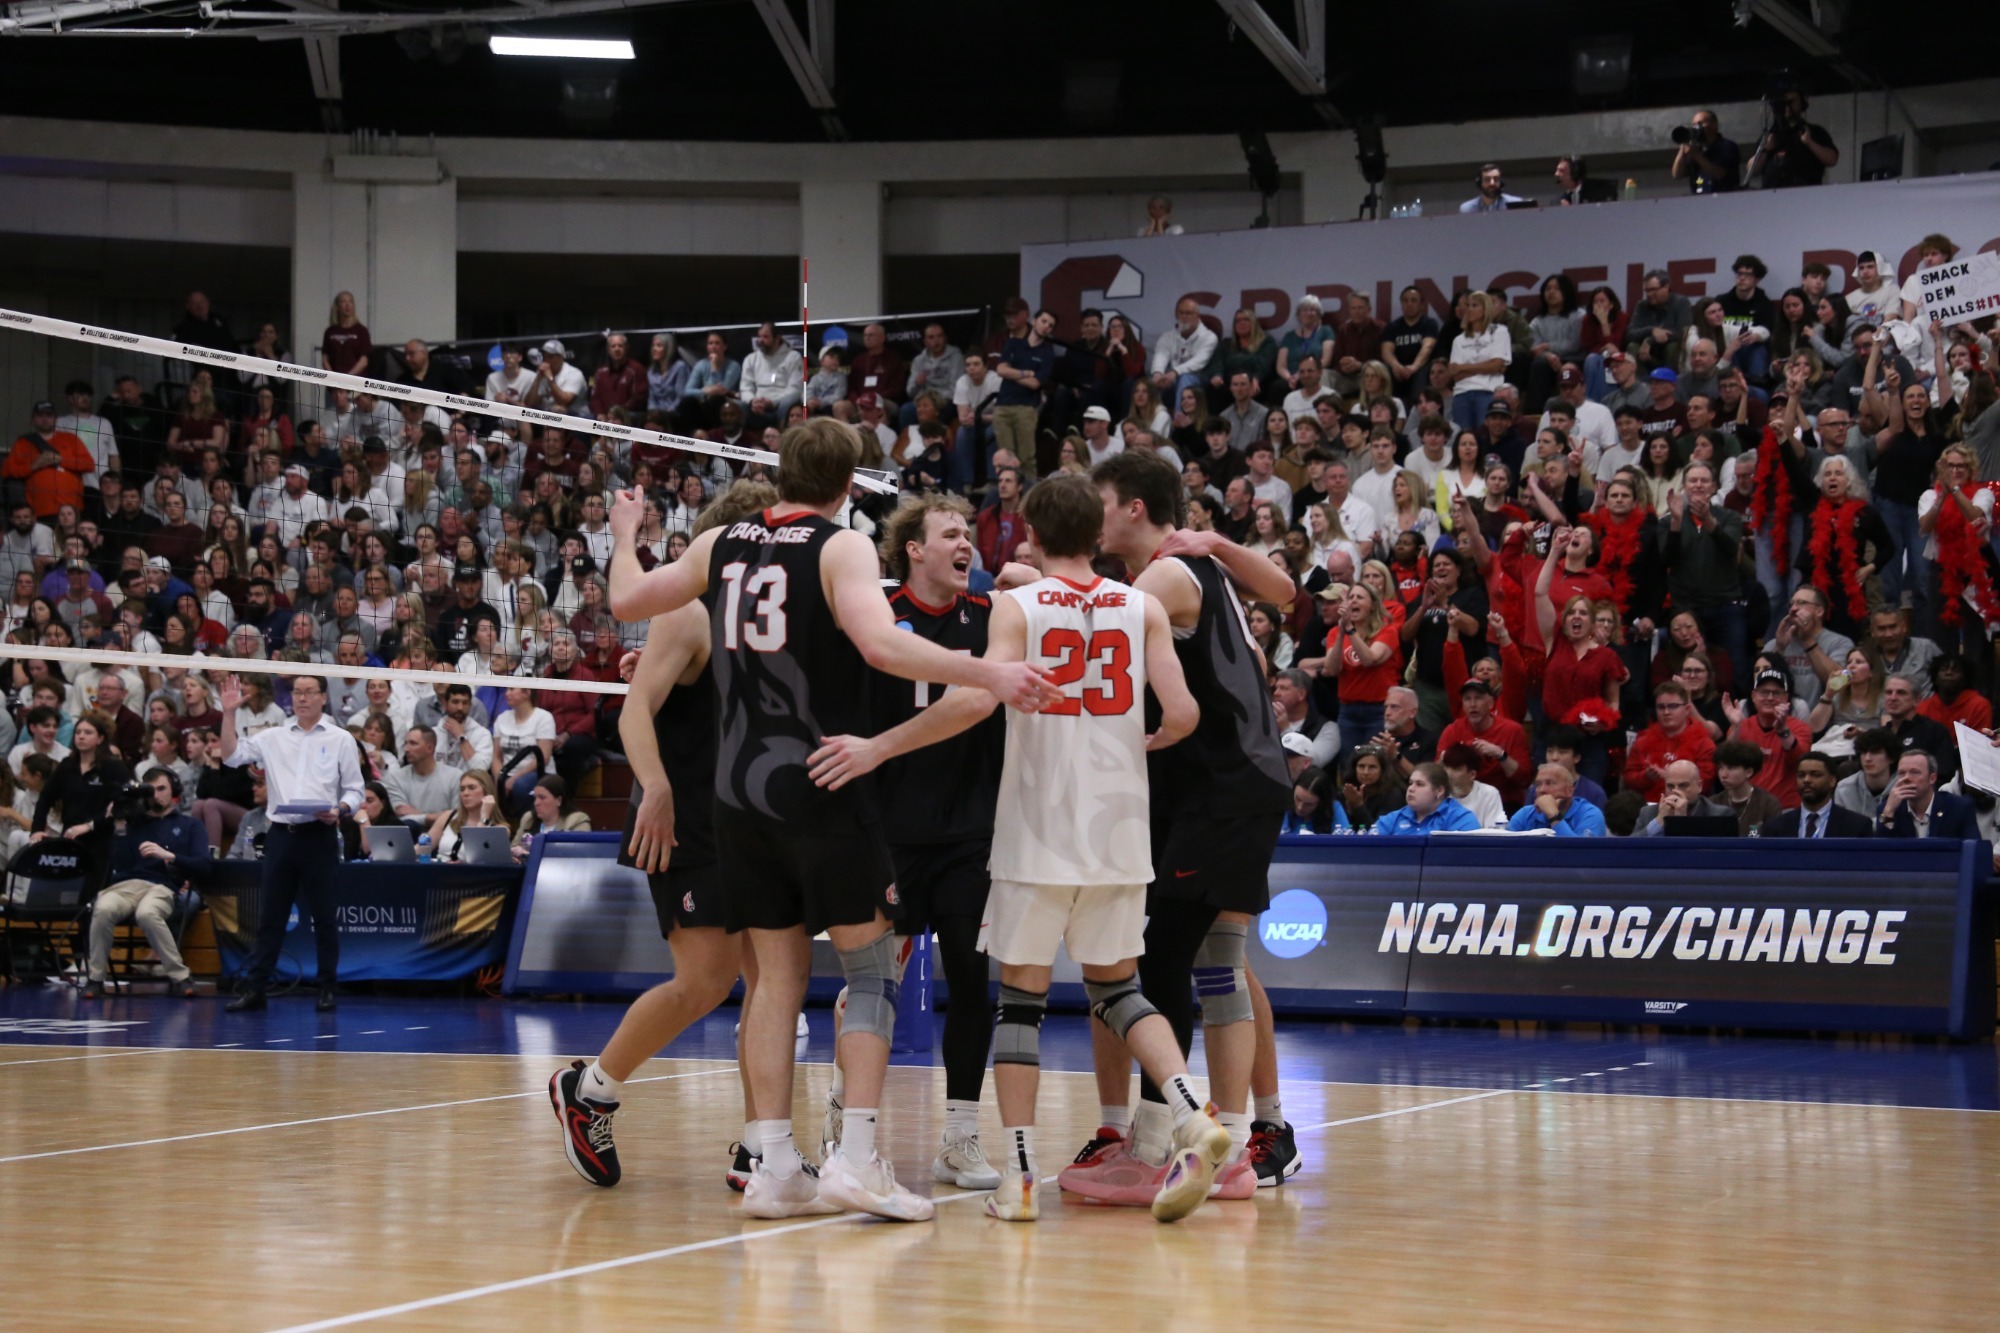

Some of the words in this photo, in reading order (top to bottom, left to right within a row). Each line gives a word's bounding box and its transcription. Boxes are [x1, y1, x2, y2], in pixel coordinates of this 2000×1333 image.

[1921, 263, 1969, 285] SMACK
[1925, 285, 1955, 304] DEM
[0, 313, 33, 324] CHAMPIONSHIP
[1929, 301, 1974, 322] BALLS
[86, 329, 109, 339] VOLLEYBALL
[109, 333, 139, 344] CHAMPIONSHIP
[188, 348, 209, 358] VOLLEYBALL
[210, 352, 237, 362] CHAMPIONSHIP
[282, 365, 301, 375] VOLLEYBALL
[302, 369, 328, 379] CHAMPIONSHIP
[721, 562, 787, 652] 13
[1038, 628, 1134, 716] 23
[39, 854, 77, 867] NCAA
[1265, 922, 1324, 941] NCAA
[1378, 902, 1908, 965] NCAA.ORG/CHANGE
[1644, 1001, 1676, 1010] VARSITY
